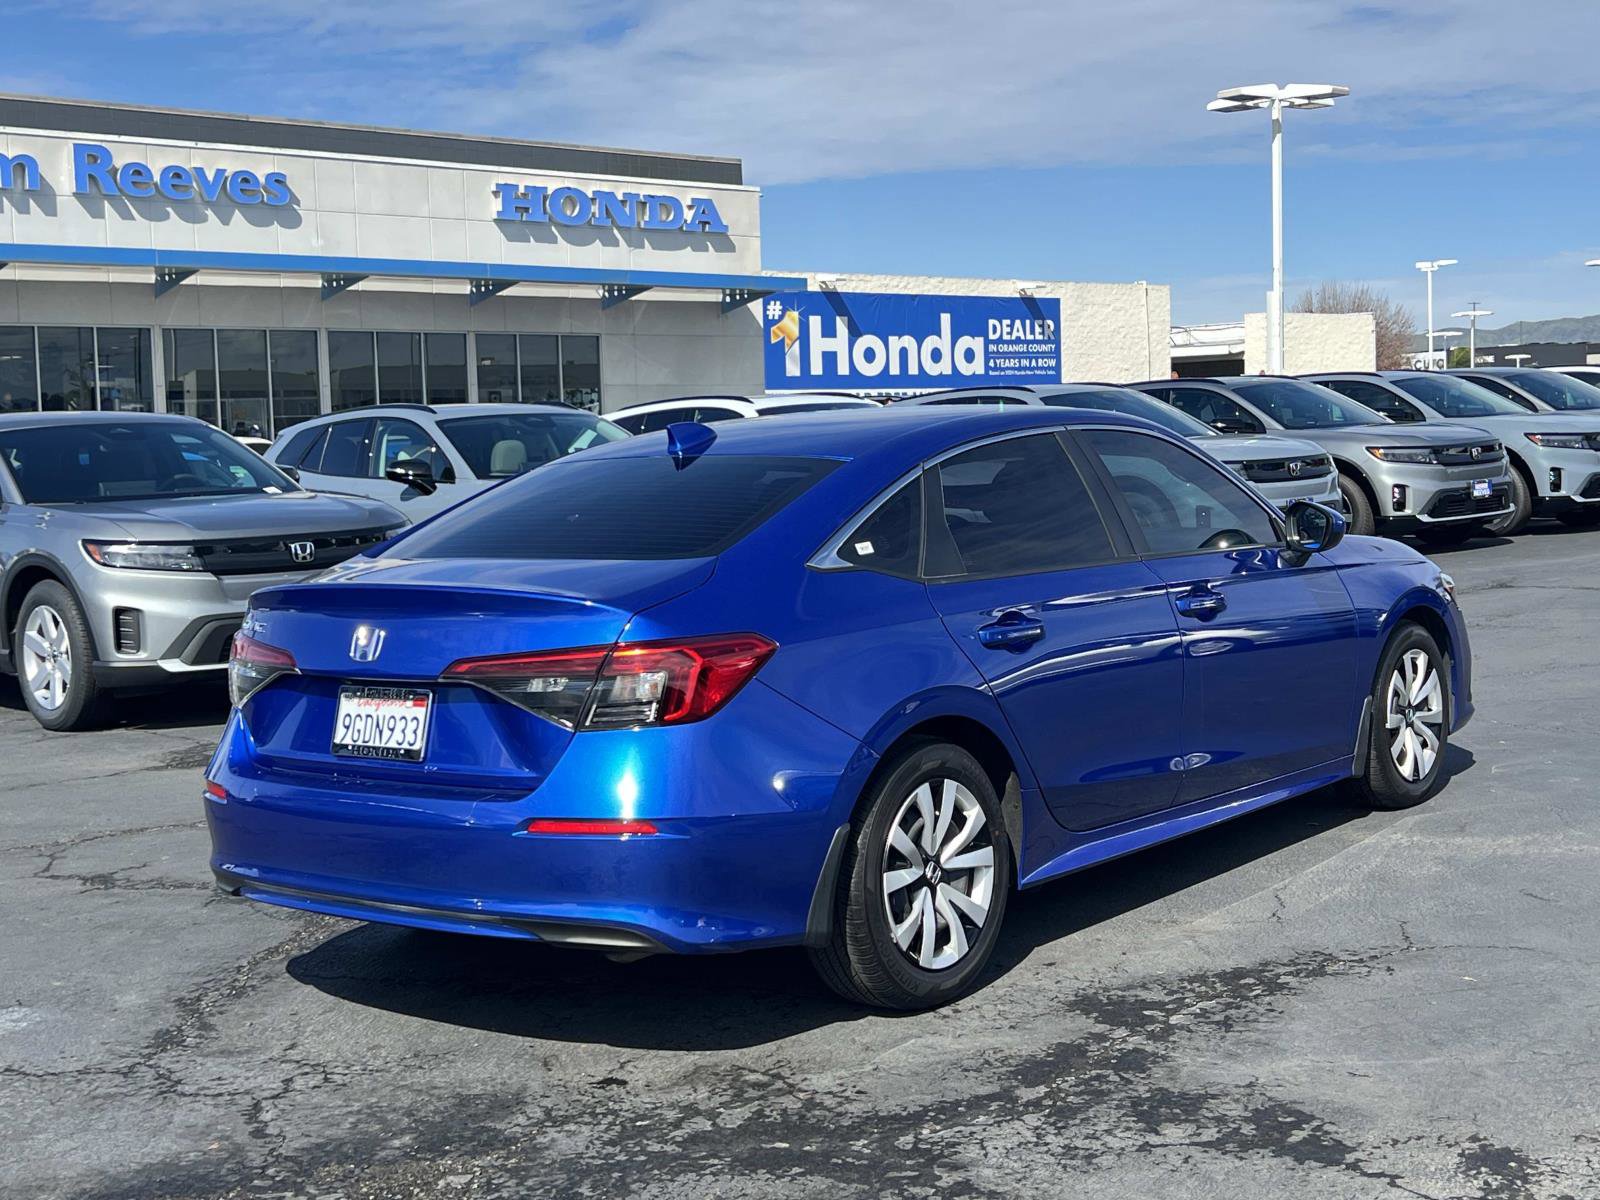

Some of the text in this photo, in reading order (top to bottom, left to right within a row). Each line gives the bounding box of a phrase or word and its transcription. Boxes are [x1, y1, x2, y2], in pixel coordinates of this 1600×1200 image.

[72, 143, 290, 206] Reeves
[495, 183, 729, 233] HONDA
[809, 313, 985, 376] Honda
[988, 319, 1055, 340] DEALER
[988, 343, 1056, 352] IN ORANGE COUNTY
[996, 359, 1019, 368] YEARS
[1021, 359, 1029, 368] IN
[1038, 359, 1056, 368] ROW
[341, 713, 419, 746] 9GDN933
